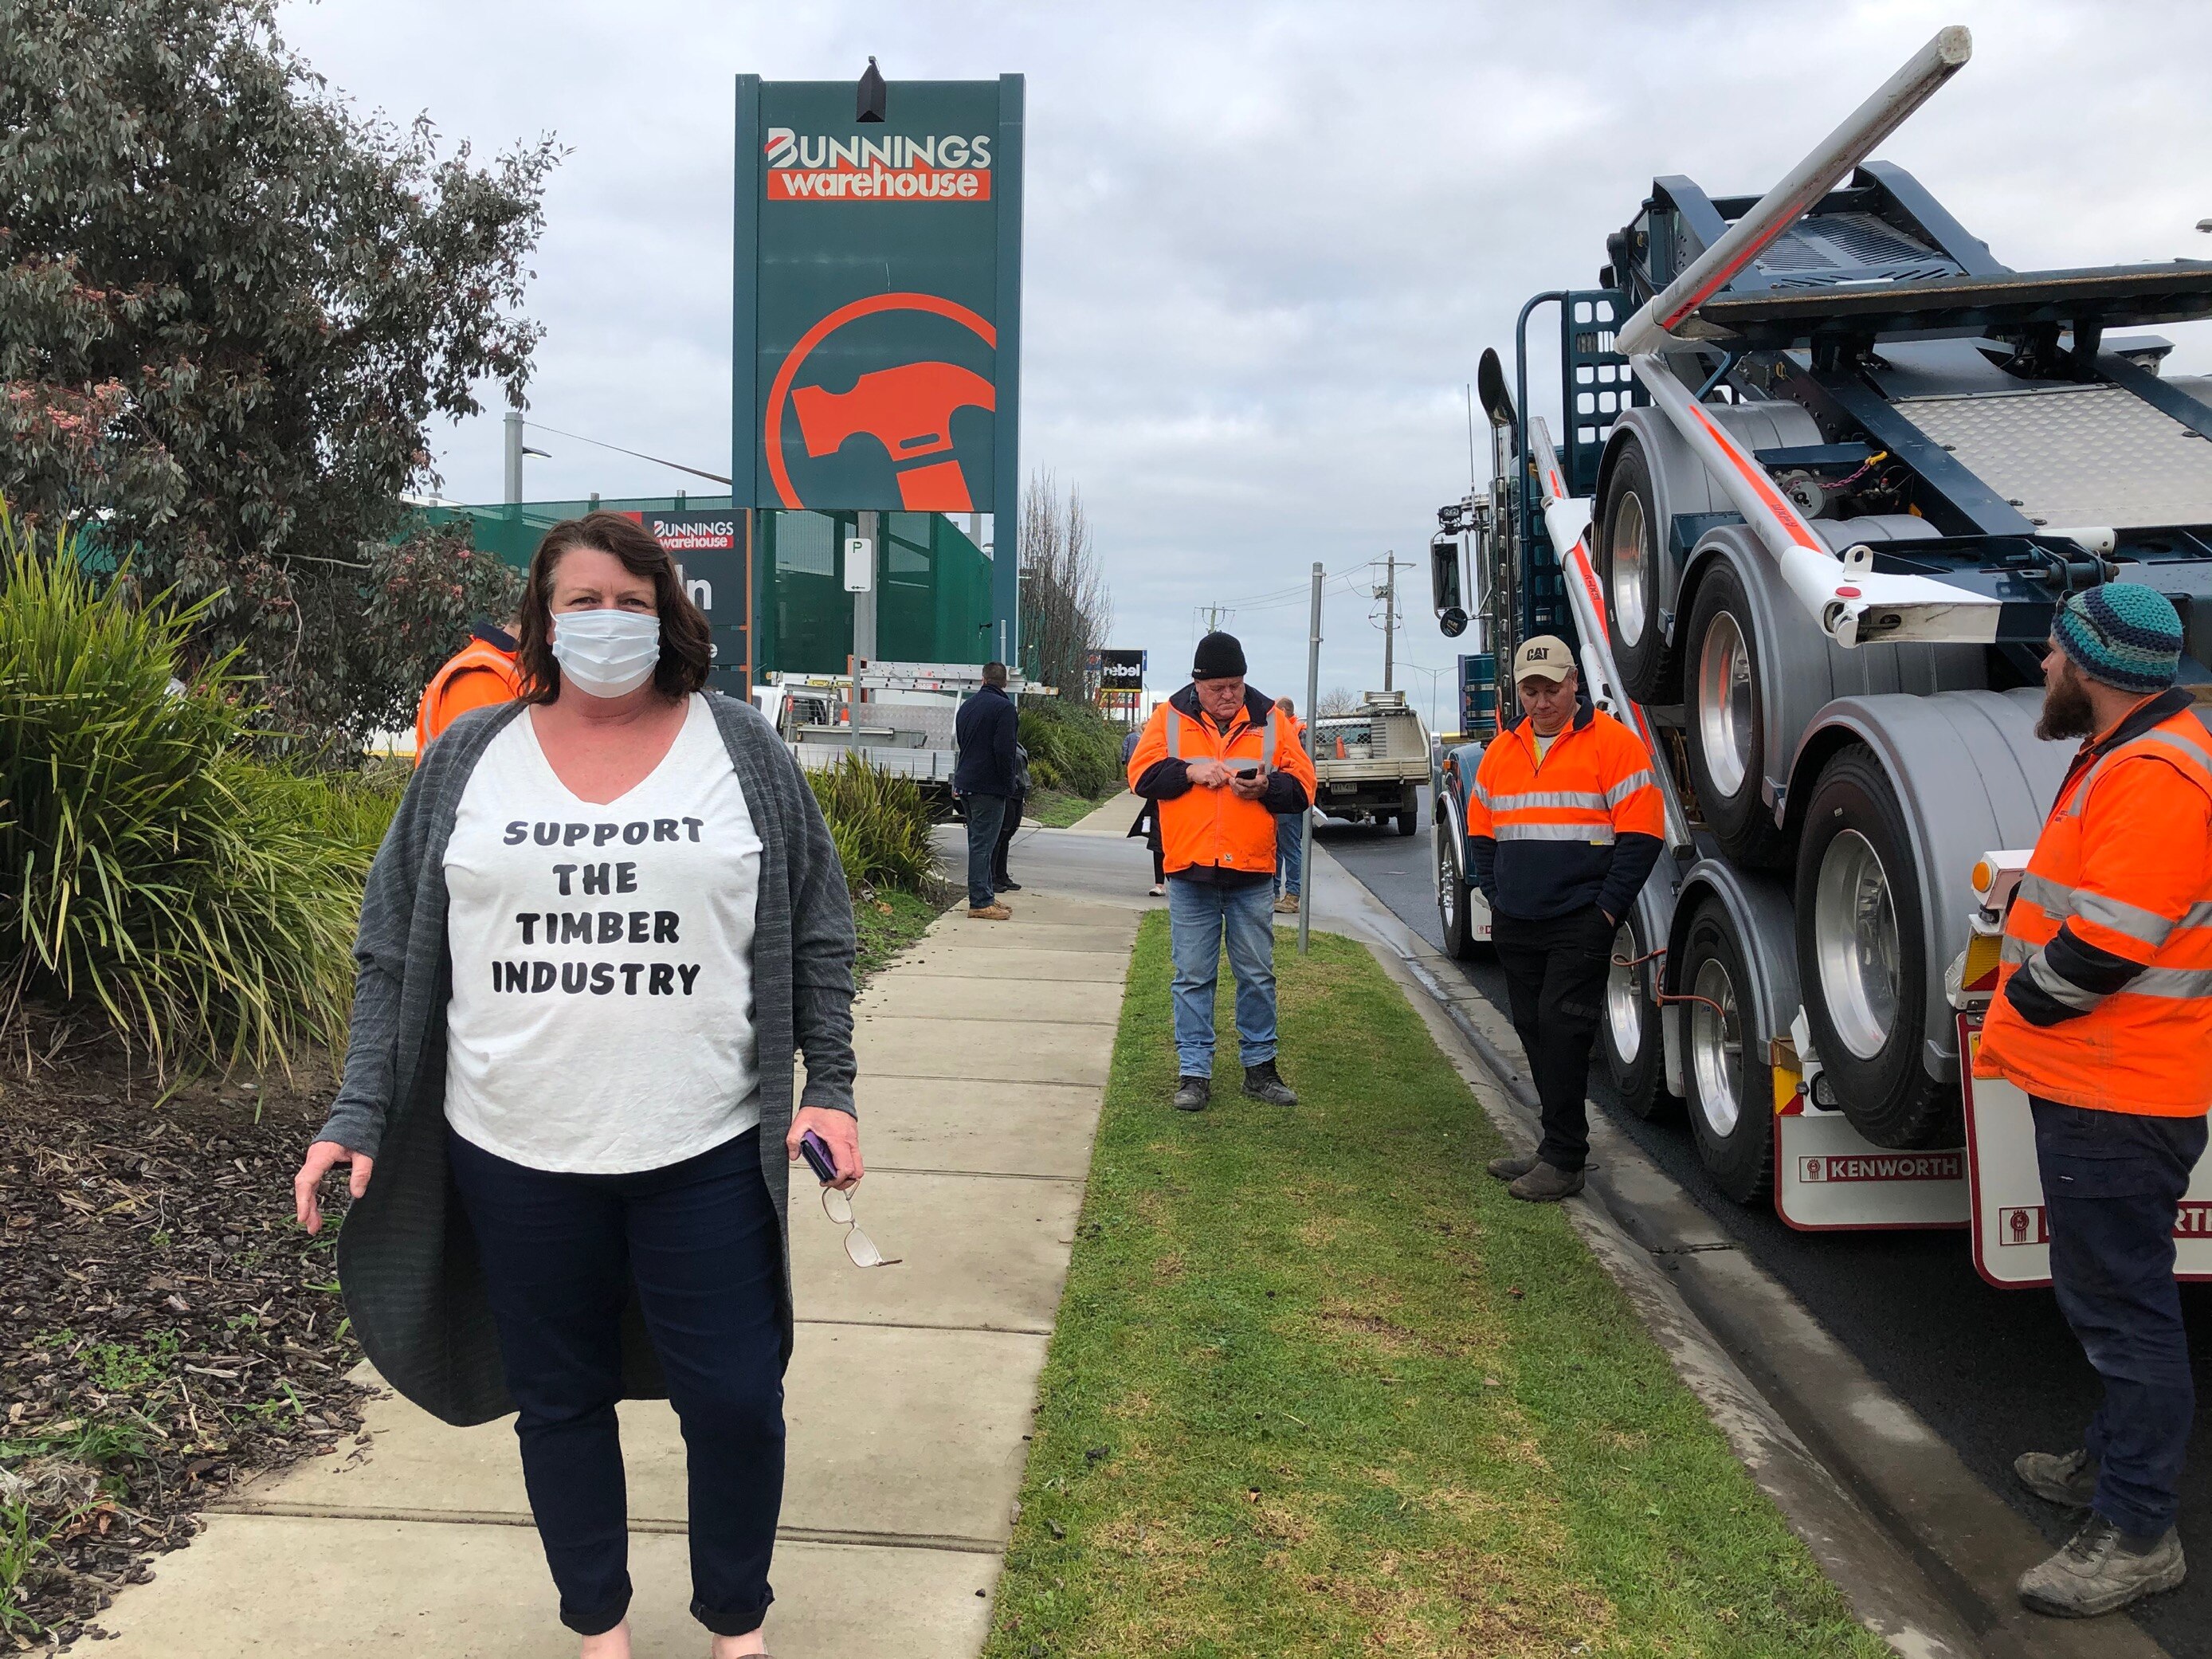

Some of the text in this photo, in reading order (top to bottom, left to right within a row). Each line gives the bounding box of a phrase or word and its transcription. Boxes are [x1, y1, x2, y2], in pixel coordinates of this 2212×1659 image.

[765, 127, 991, 169] BUNNINGS
[781, 163, 979, 197] warehouse
[653, 520, 734, 536] BUNNINGS
[660, 533, 728, 548] warehouse
[853, 542, 862, 553] P
[1527, 647, 1549, 661] CAT
[1104, 664, 1140, 677] rebel
[503, 816, 704, 847] SUPPORT
[552, 861, 637, 896] THE
[516, 911, 680, 945] TIMBER
[492, 960, 701, 996] INDUSTRY
[1830, 1157, 1959, 1178] KENWORTH
